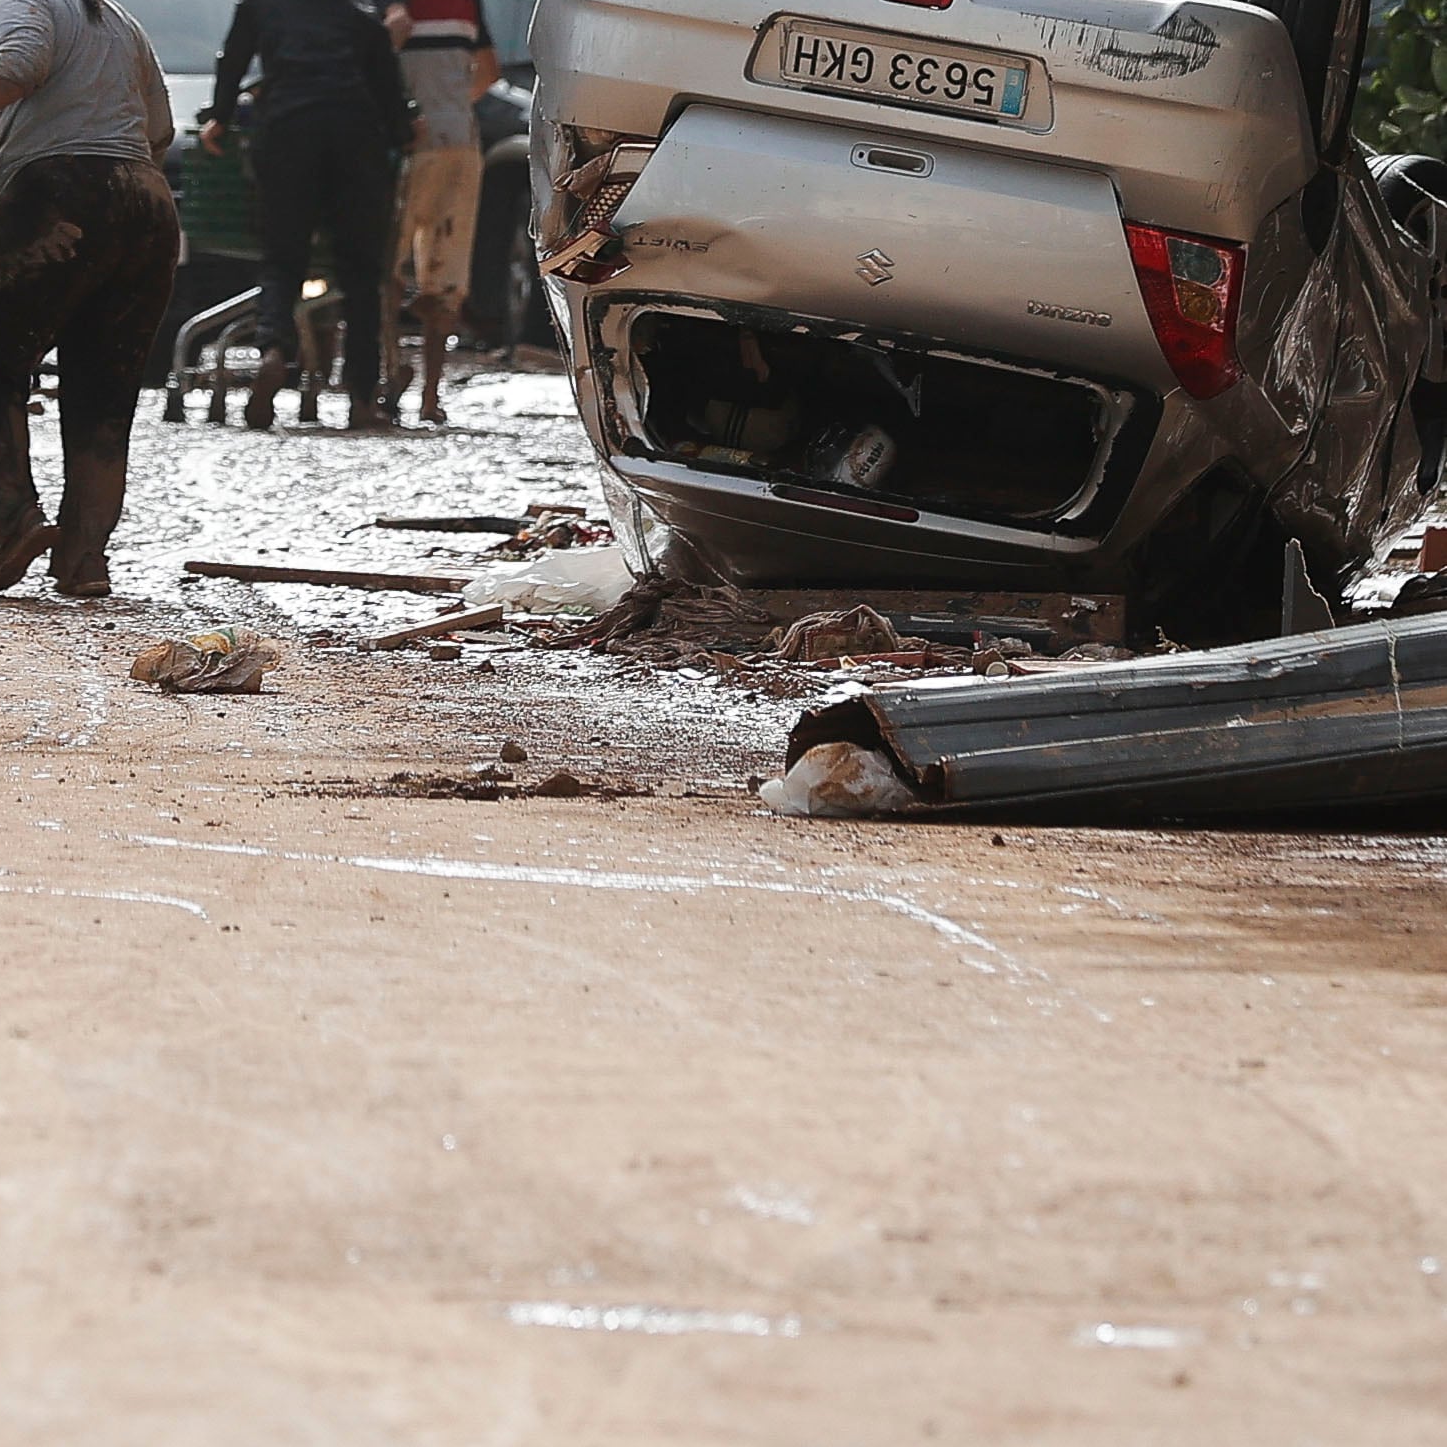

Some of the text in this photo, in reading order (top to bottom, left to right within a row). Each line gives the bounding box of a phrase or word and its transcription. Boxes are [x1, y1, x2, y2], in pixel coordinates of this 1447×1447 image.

[793, 36, 874, 84] GKH
[888, 53, 995, 106] 5633
[1027, 300, 1112, 327] SUZUKI
